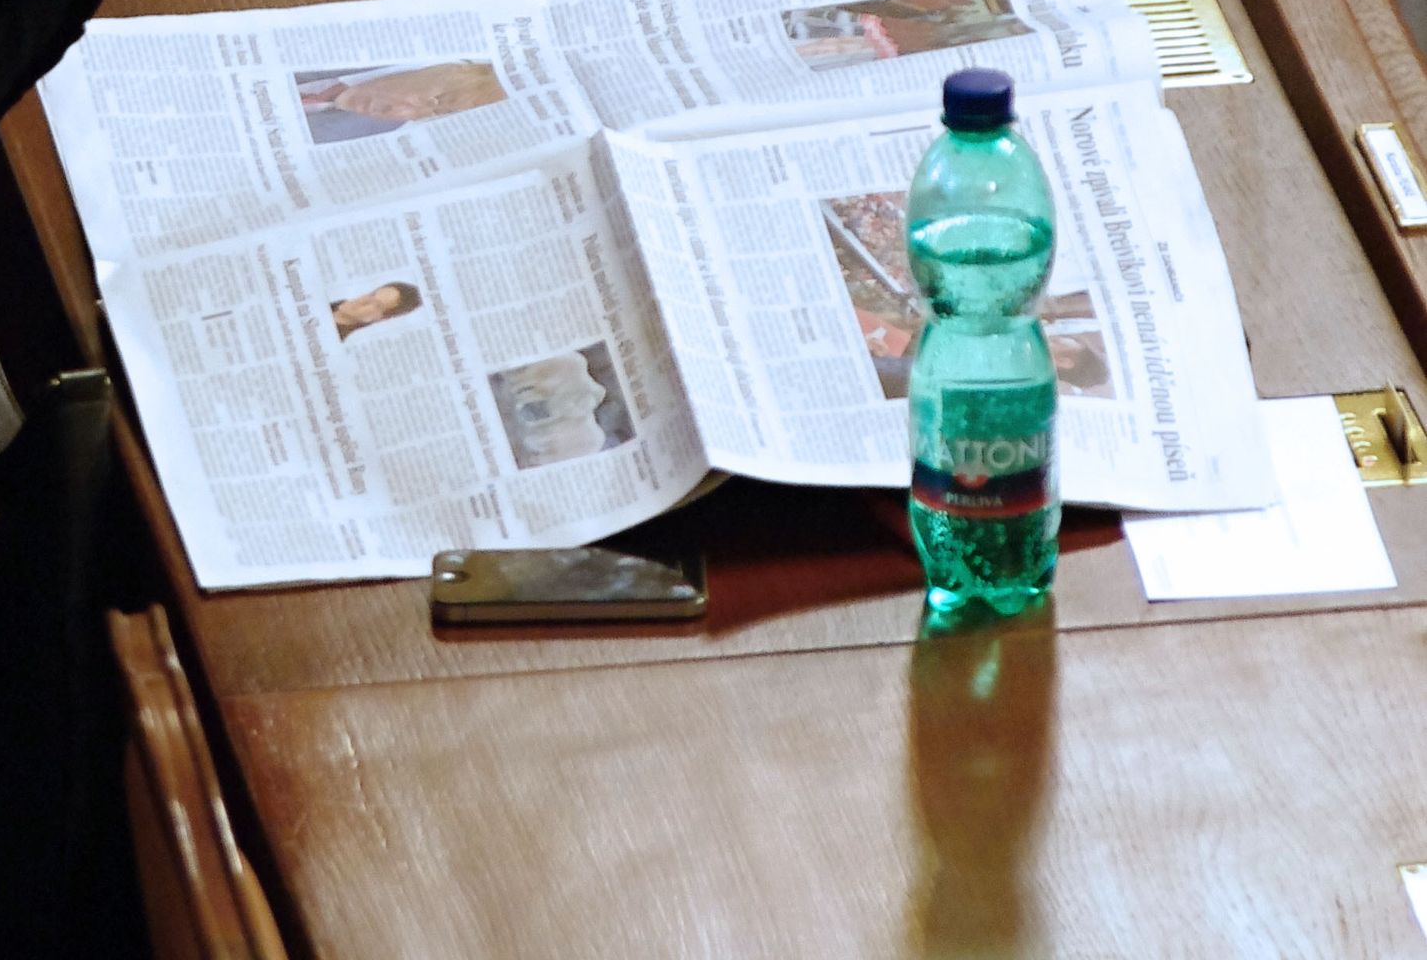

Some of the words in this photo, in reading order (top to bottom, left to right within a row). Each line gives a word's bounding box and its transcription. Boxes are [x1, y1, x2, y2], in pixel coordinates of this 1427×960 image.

[1066, 105, 1112, 167] Norové
[1080, 168, 1128, 218] zpívali
[1103, 220, 1156, 296] Breivikovi
[1130, 300, 1177, 424] nenáviděnou
[1151, 430, 1196, 482] píseň
